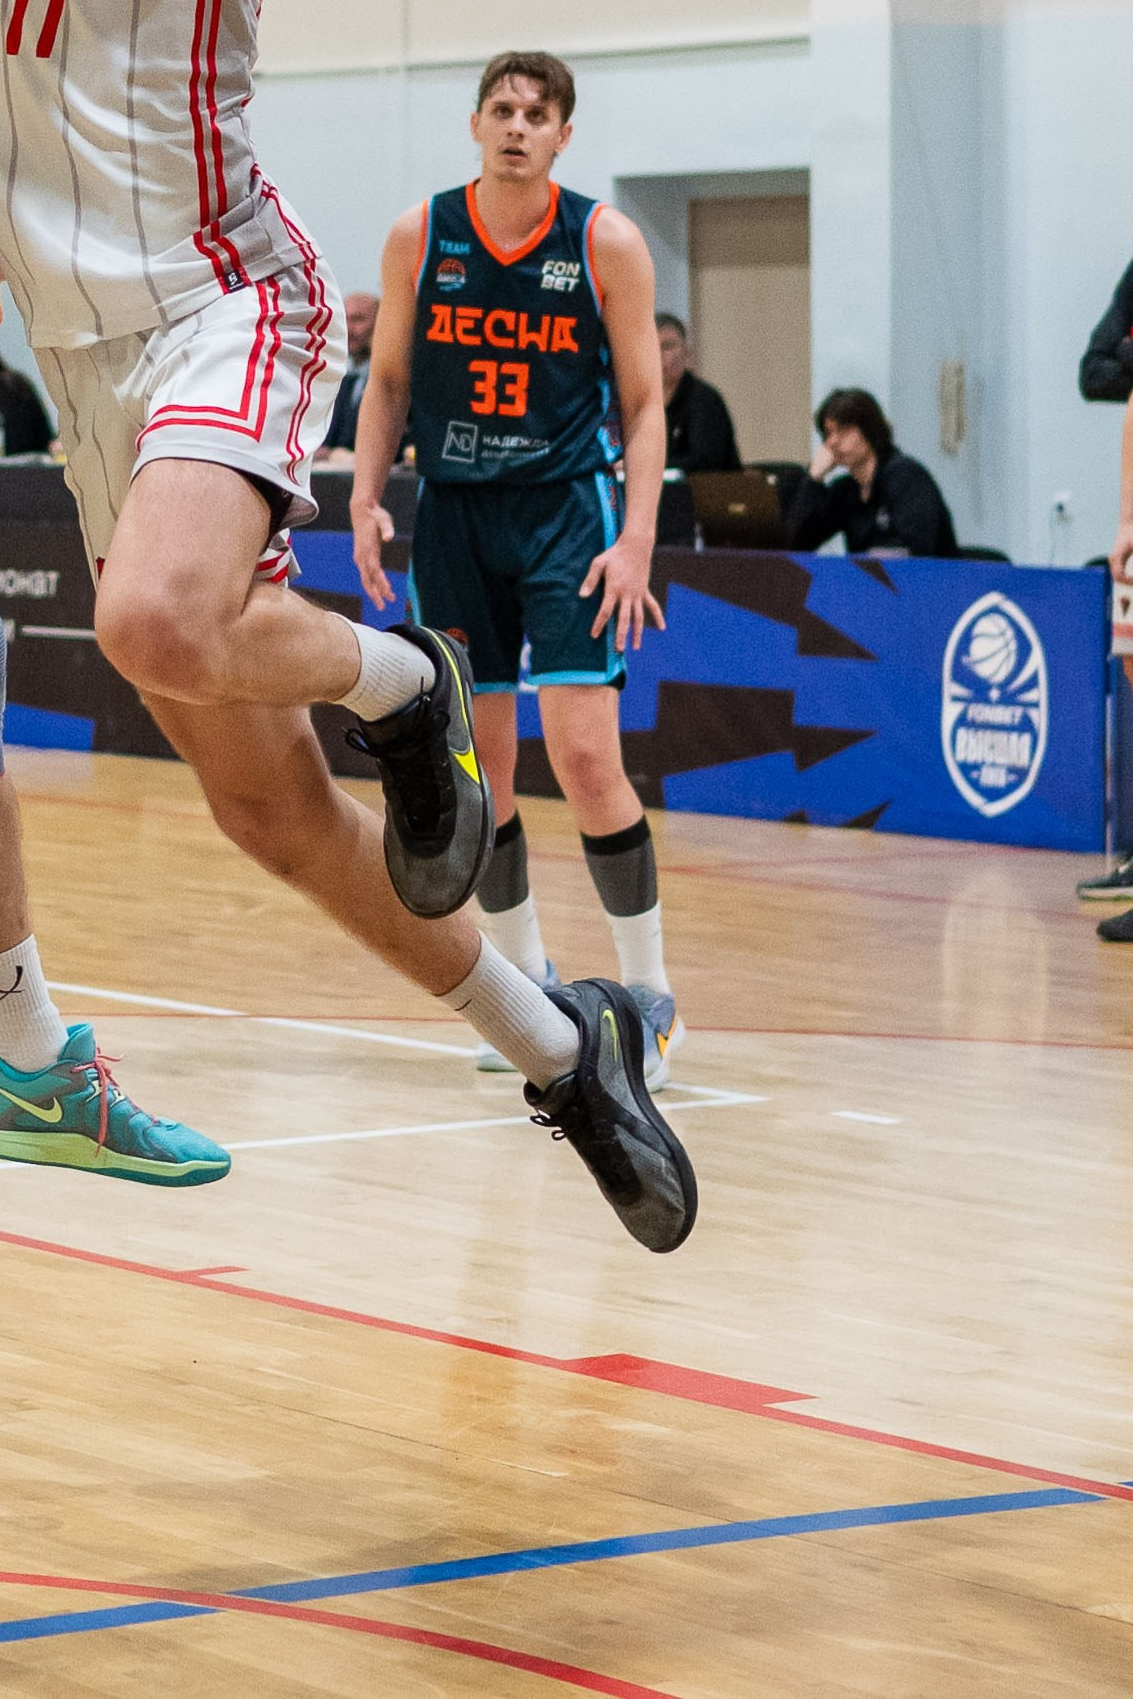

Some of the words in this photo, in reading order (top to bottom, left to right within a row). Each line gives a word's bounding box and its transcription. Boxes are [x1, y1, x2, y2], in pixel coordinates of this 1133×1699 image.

[540, 274, 580, 293] BET
[542, 260, 581, 277] FON
[426, 304, 579, 353] ДЕСНА
[468, 359, 530, 418] 33
